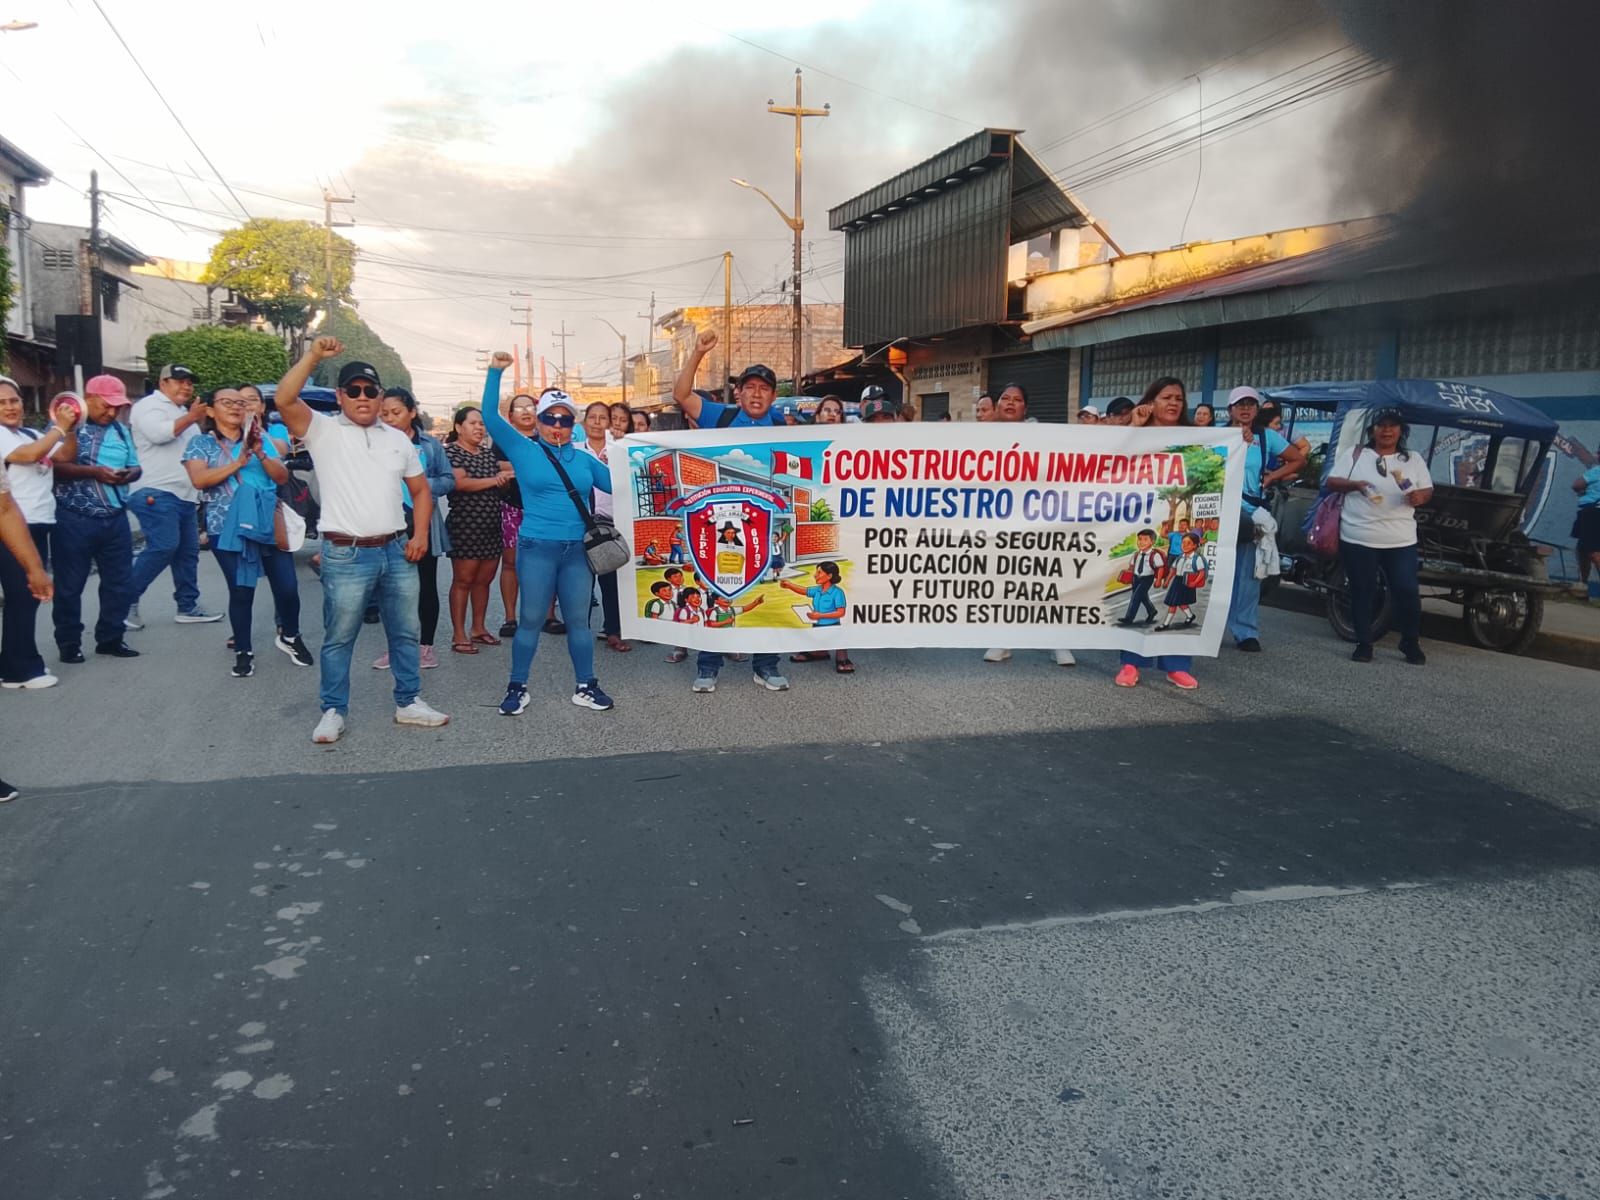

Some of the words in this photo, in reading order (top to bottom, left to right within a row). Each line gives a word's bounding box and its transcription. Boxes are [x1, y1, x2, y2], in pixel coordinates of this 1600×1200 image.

[822, 443, 1040, 485] ¡CONSTRUCCIÓN
[1046, 452, 1186, 486] INMEDIATA
[839, 486, 877, 519] DE
[884, 486, 1014, 520] NUESTRO
[1022, 488, 1156, 524] COLEGIO!
[1196, 509, 1218, 517] DIGNAS
[864, 527, 908, 548] POR
[915, 527, 987, 549] AULAS
[995, 531, 1103, 557] SEGURAS,
[867, 549, 987, 575] EDUCACIÓN
[996, 555, 1063, 578] DIGNA
[1073, 558, 1088, 579] Y
[716, 576, 744, 585] IQUITOS
[889, 579, 903, 599] Y
[912, 579, 995, 600] FUTURO
[1003, 580, 1060, 602] PARA
[853, 603, 958, 624] NUESTROS
[966, 604, 1106, 625] ESTUDIANTES.
